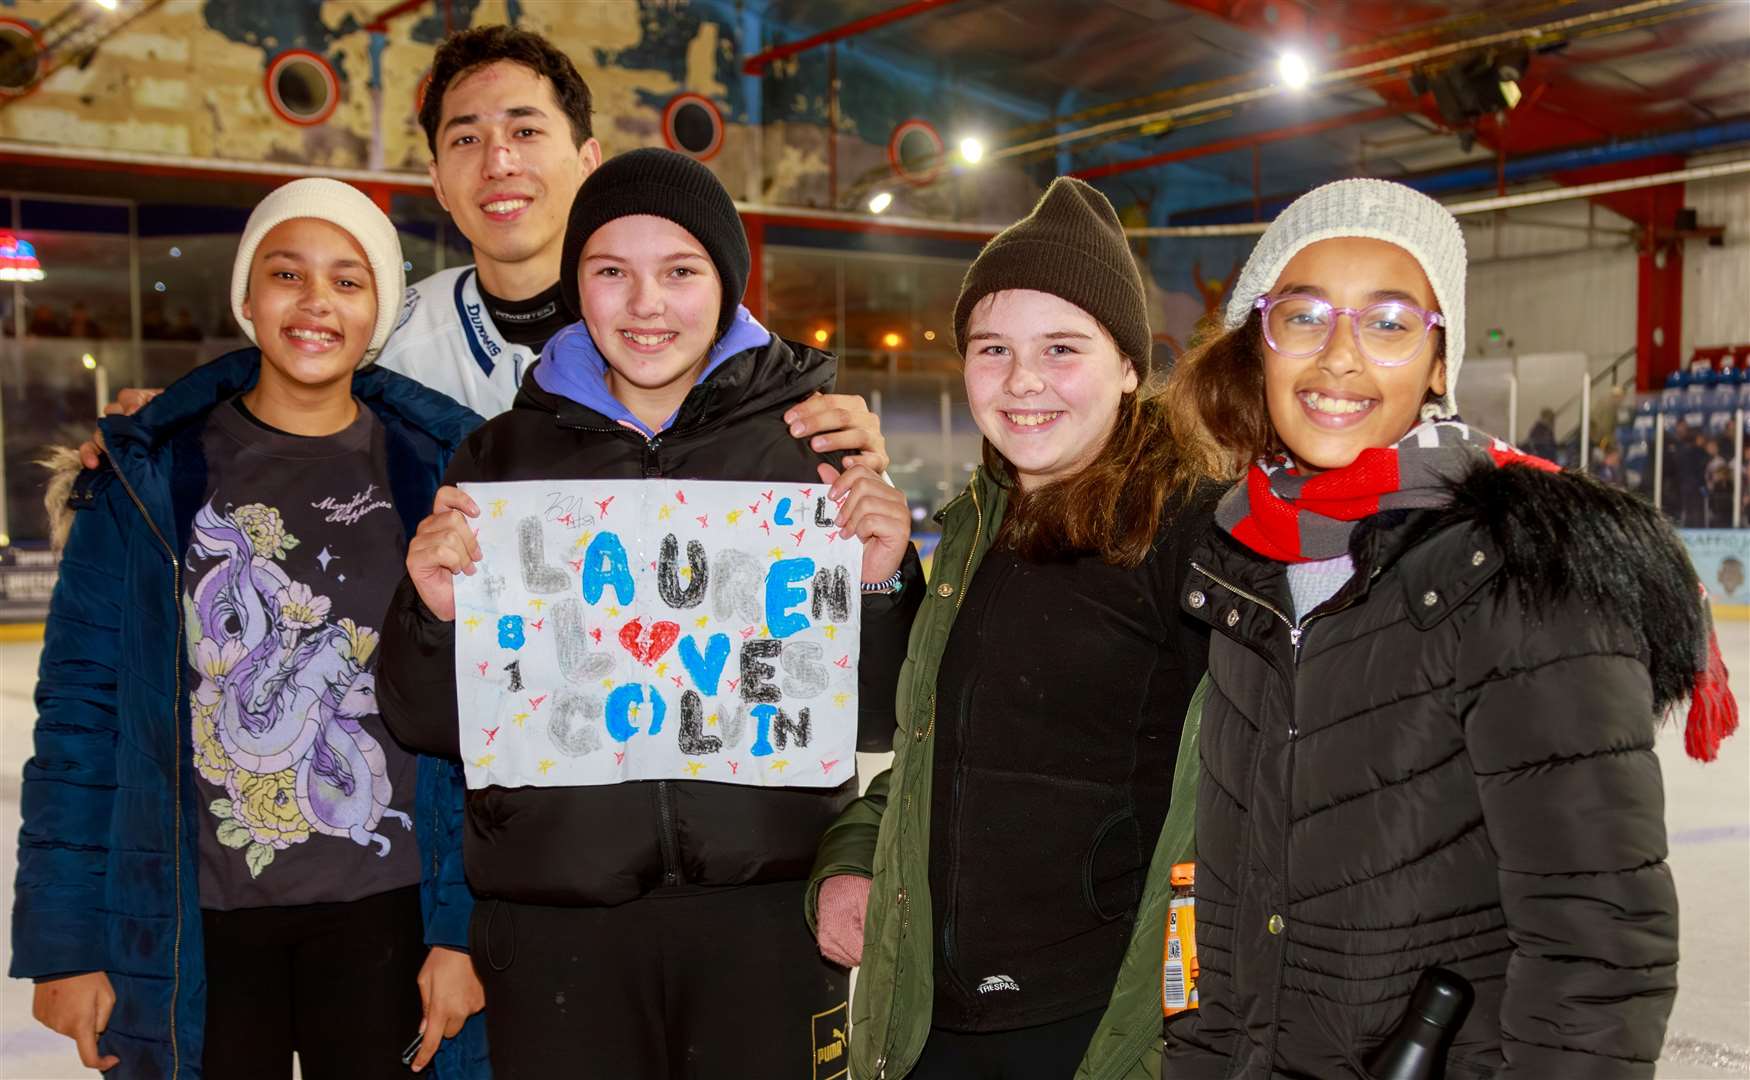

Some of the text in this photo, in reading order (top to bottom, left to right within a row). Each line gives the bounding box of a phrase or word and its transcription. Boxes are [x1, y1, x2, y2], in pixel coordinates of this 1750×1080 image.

[515, 514, 852, 639] LAUREN
[547, 681, 813, 758] COLVIN
[817, 1040, 842, 1064] PUMA
